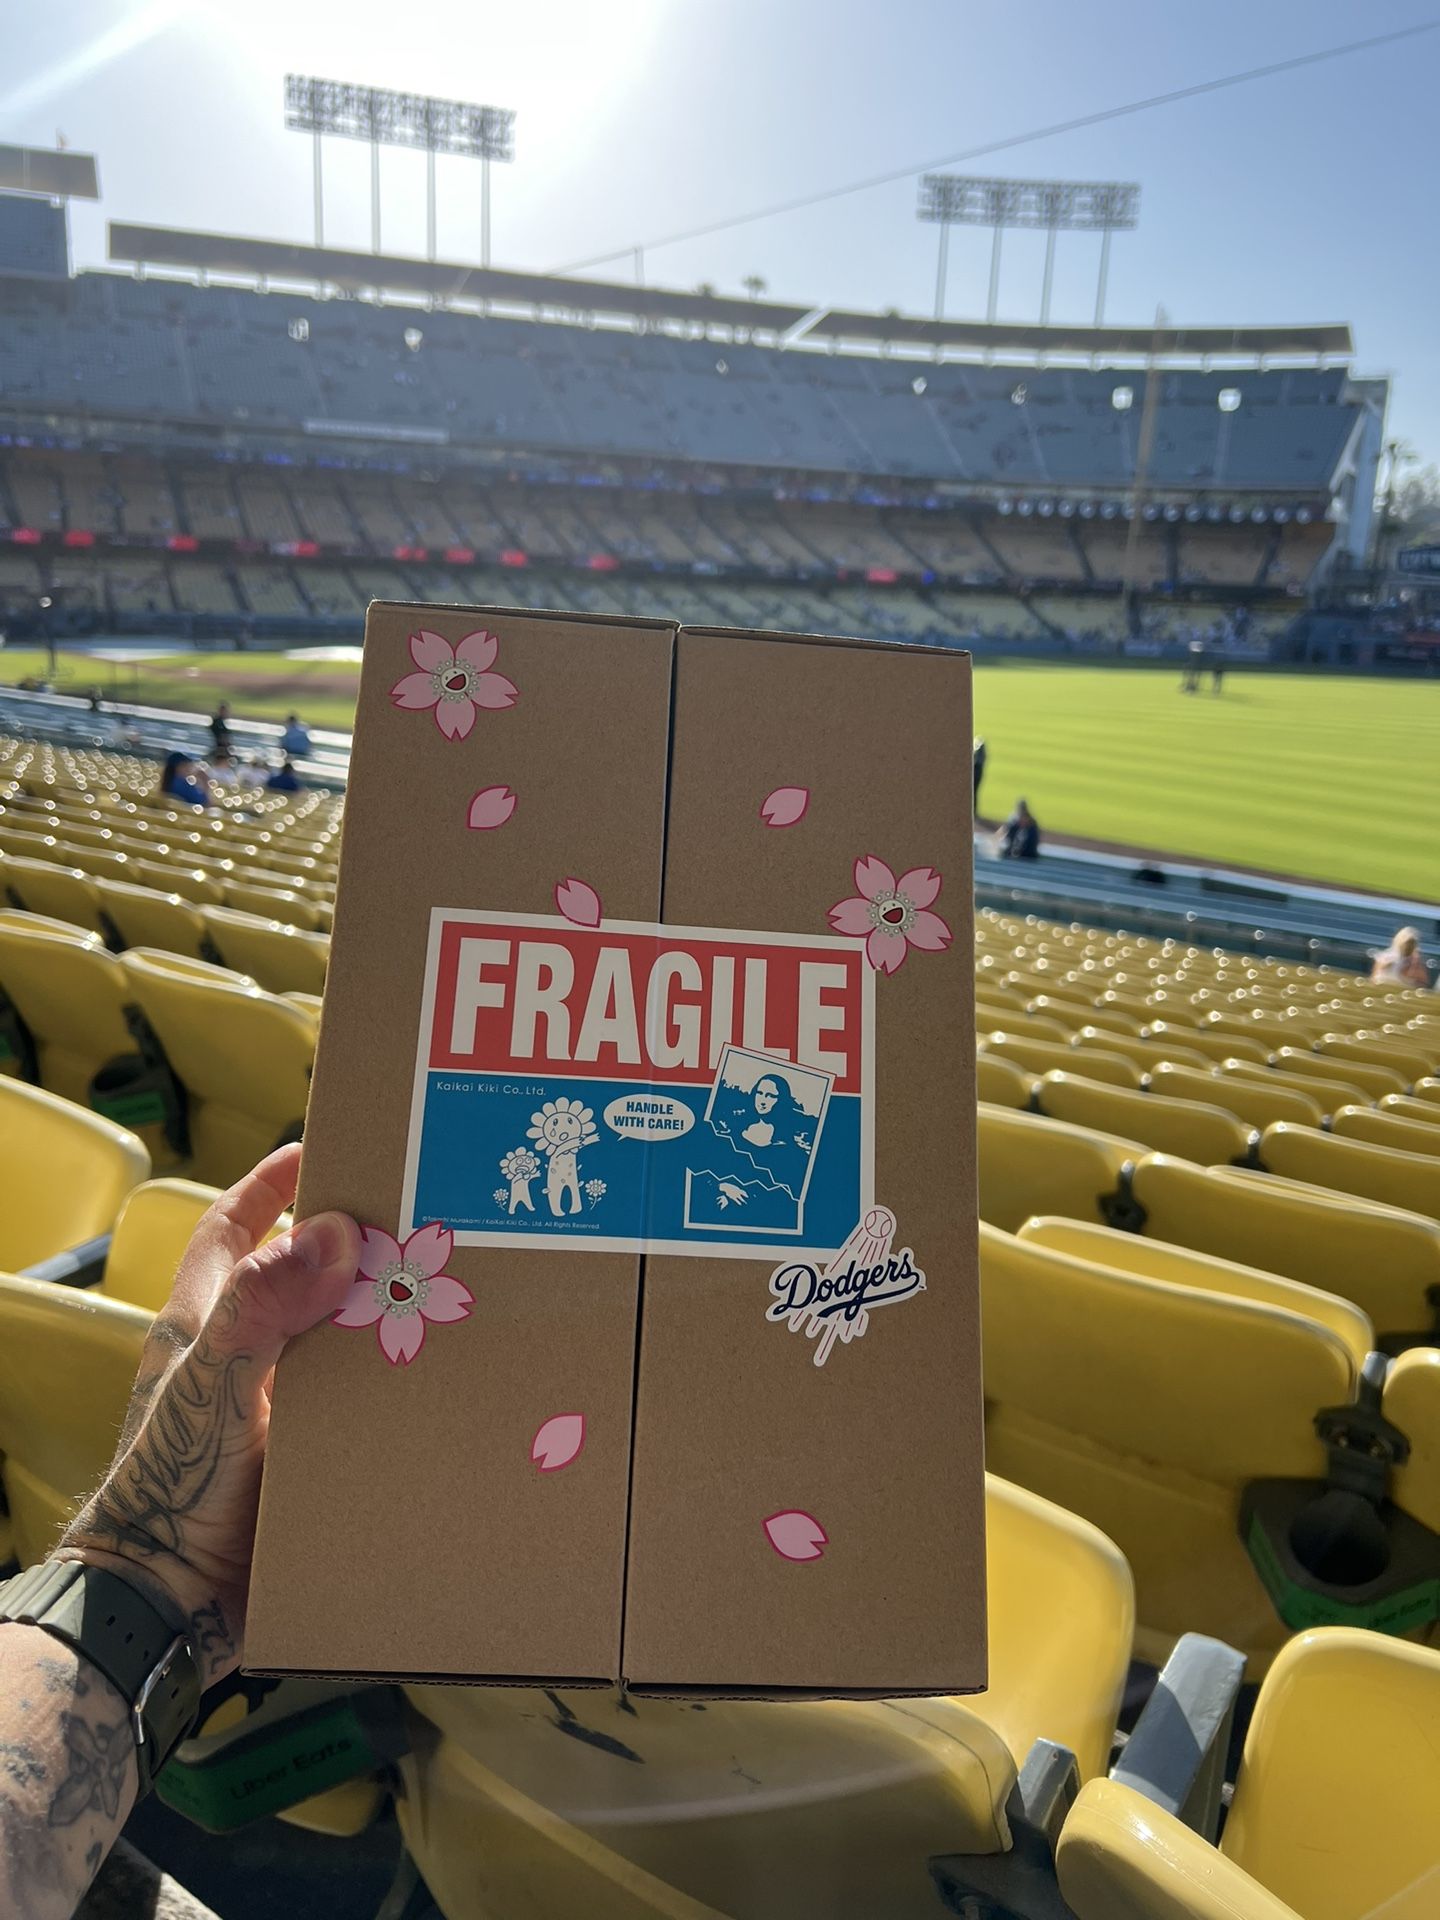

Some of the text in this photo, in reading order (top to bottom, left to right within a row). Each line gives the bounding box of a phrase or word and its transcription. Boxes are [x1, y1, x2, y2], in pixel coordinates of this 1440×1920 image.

[449, 936, 848, 1078] FRAGILE
[436, 1081, 474, 1092] Kaikai
[478, 1083, 499, 1093] Kiki
[625, 1100, 674, 1115] HANDLE
[613, 1115, 685, 1131] WITH CARE!
[450, 1217, 481, 1225] Murakami
[553, 1221, 571, 1229] Rights
[773, 1252, 920, 1321] Dodgers
[229, 1765, 289, 1800] Uber
[292, 1738, 352, 1773] Eats
